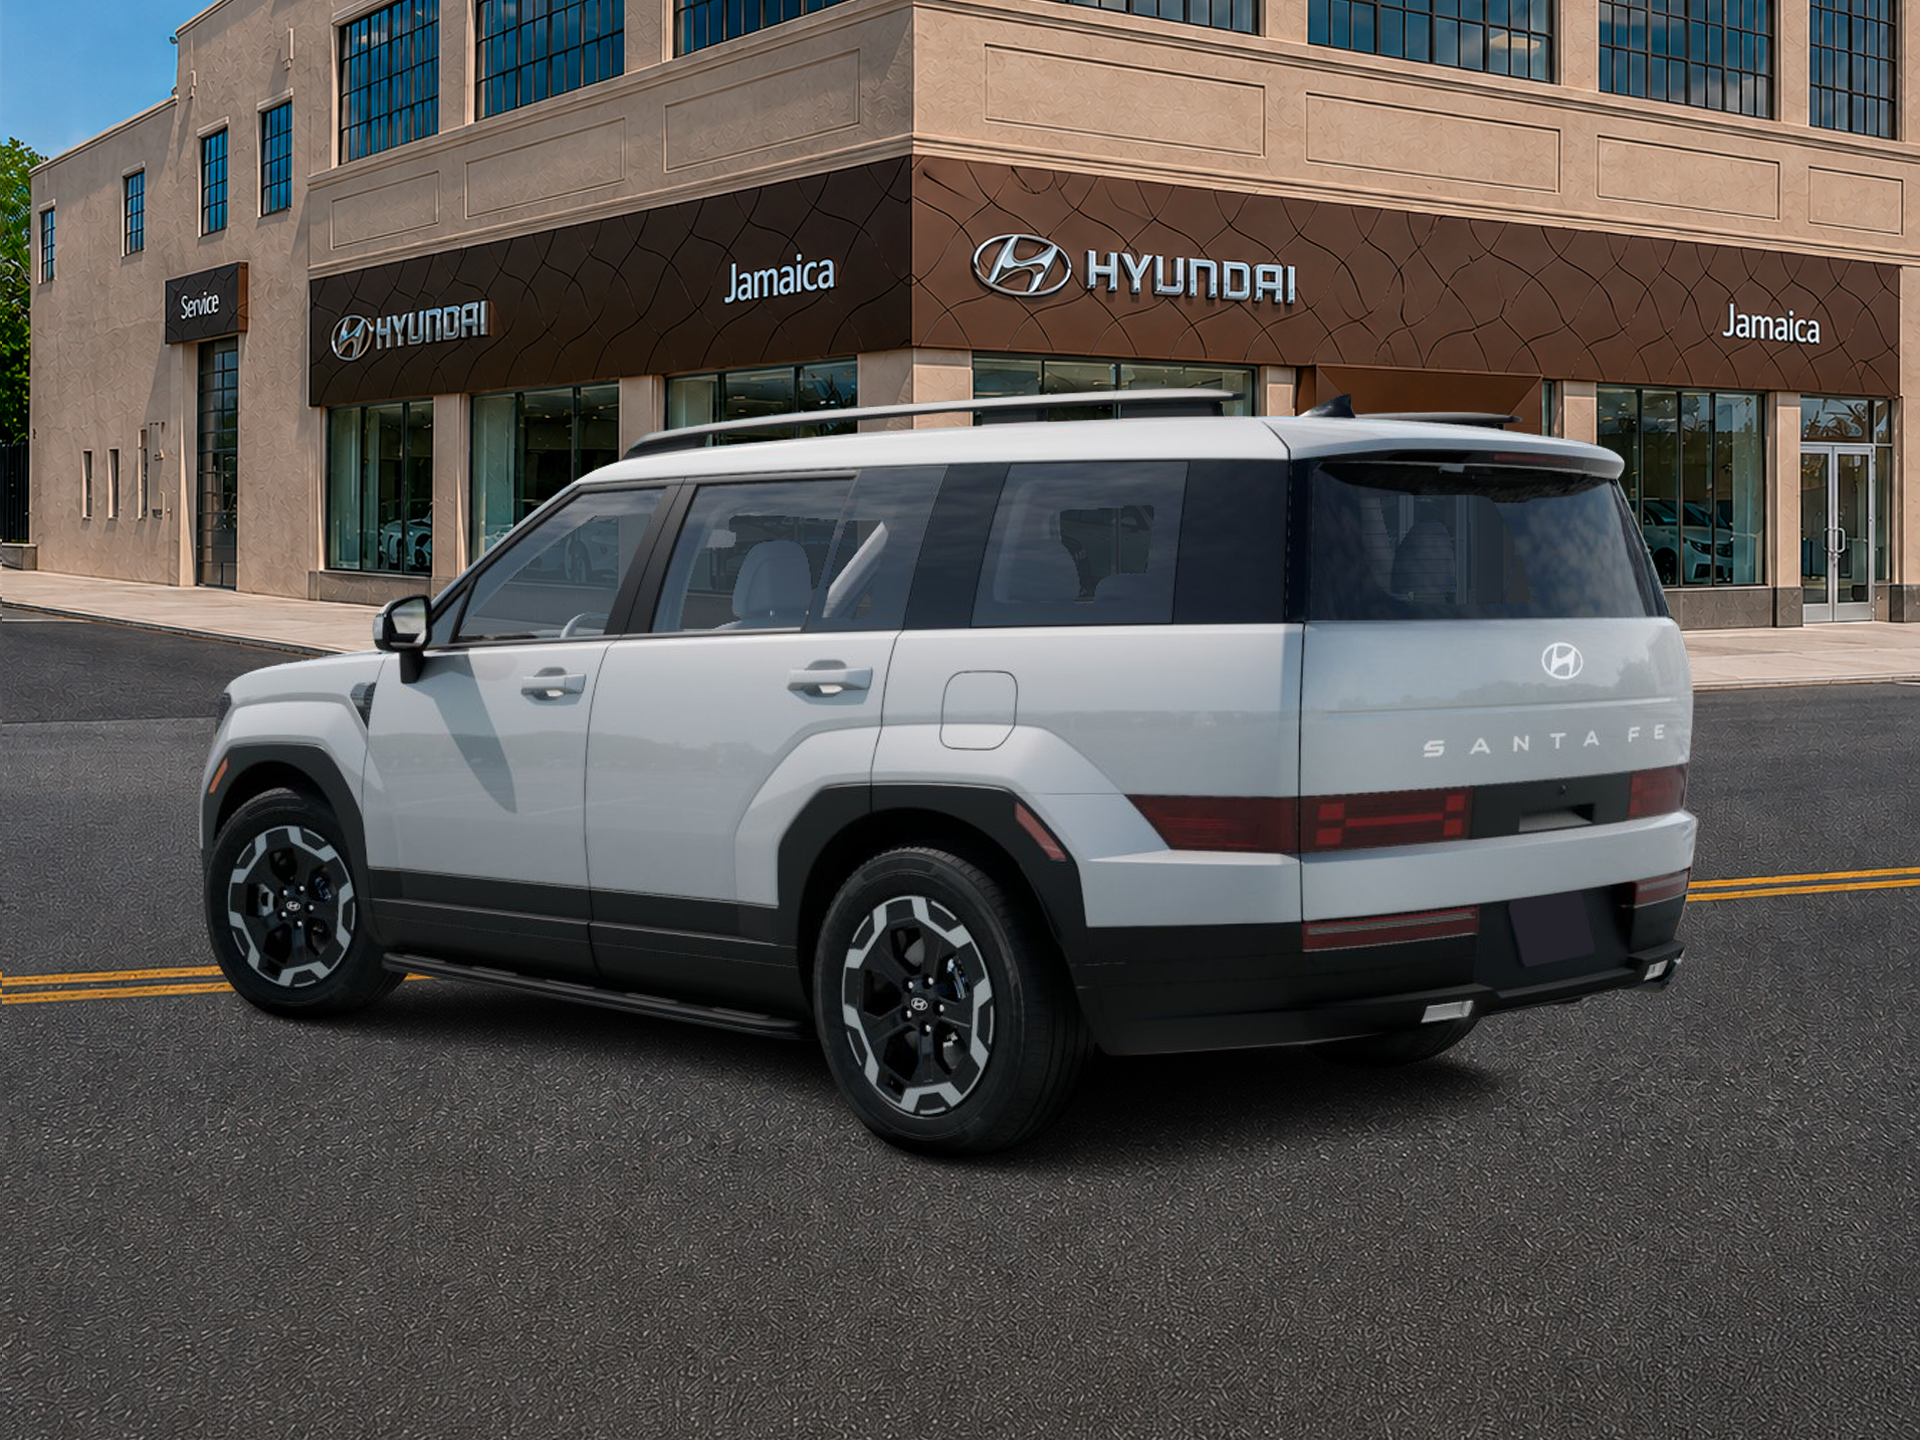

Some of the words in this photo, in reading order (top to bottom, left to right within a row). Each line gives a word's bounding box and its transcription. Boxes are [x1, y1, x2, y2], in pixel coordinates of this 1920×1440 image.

[724, 253, 835, 304] Jamaica
[1086, 249, 1296, 305] HYUNDAI
[180, 291, 220, 320] Service
[375, 300, 490, 350] HYUNDAI
[1721, 302, 1821, 345] Jamaica
[1422, 730, 1600, 758] SANTA
[1627, 723, 1666, 743] FE
